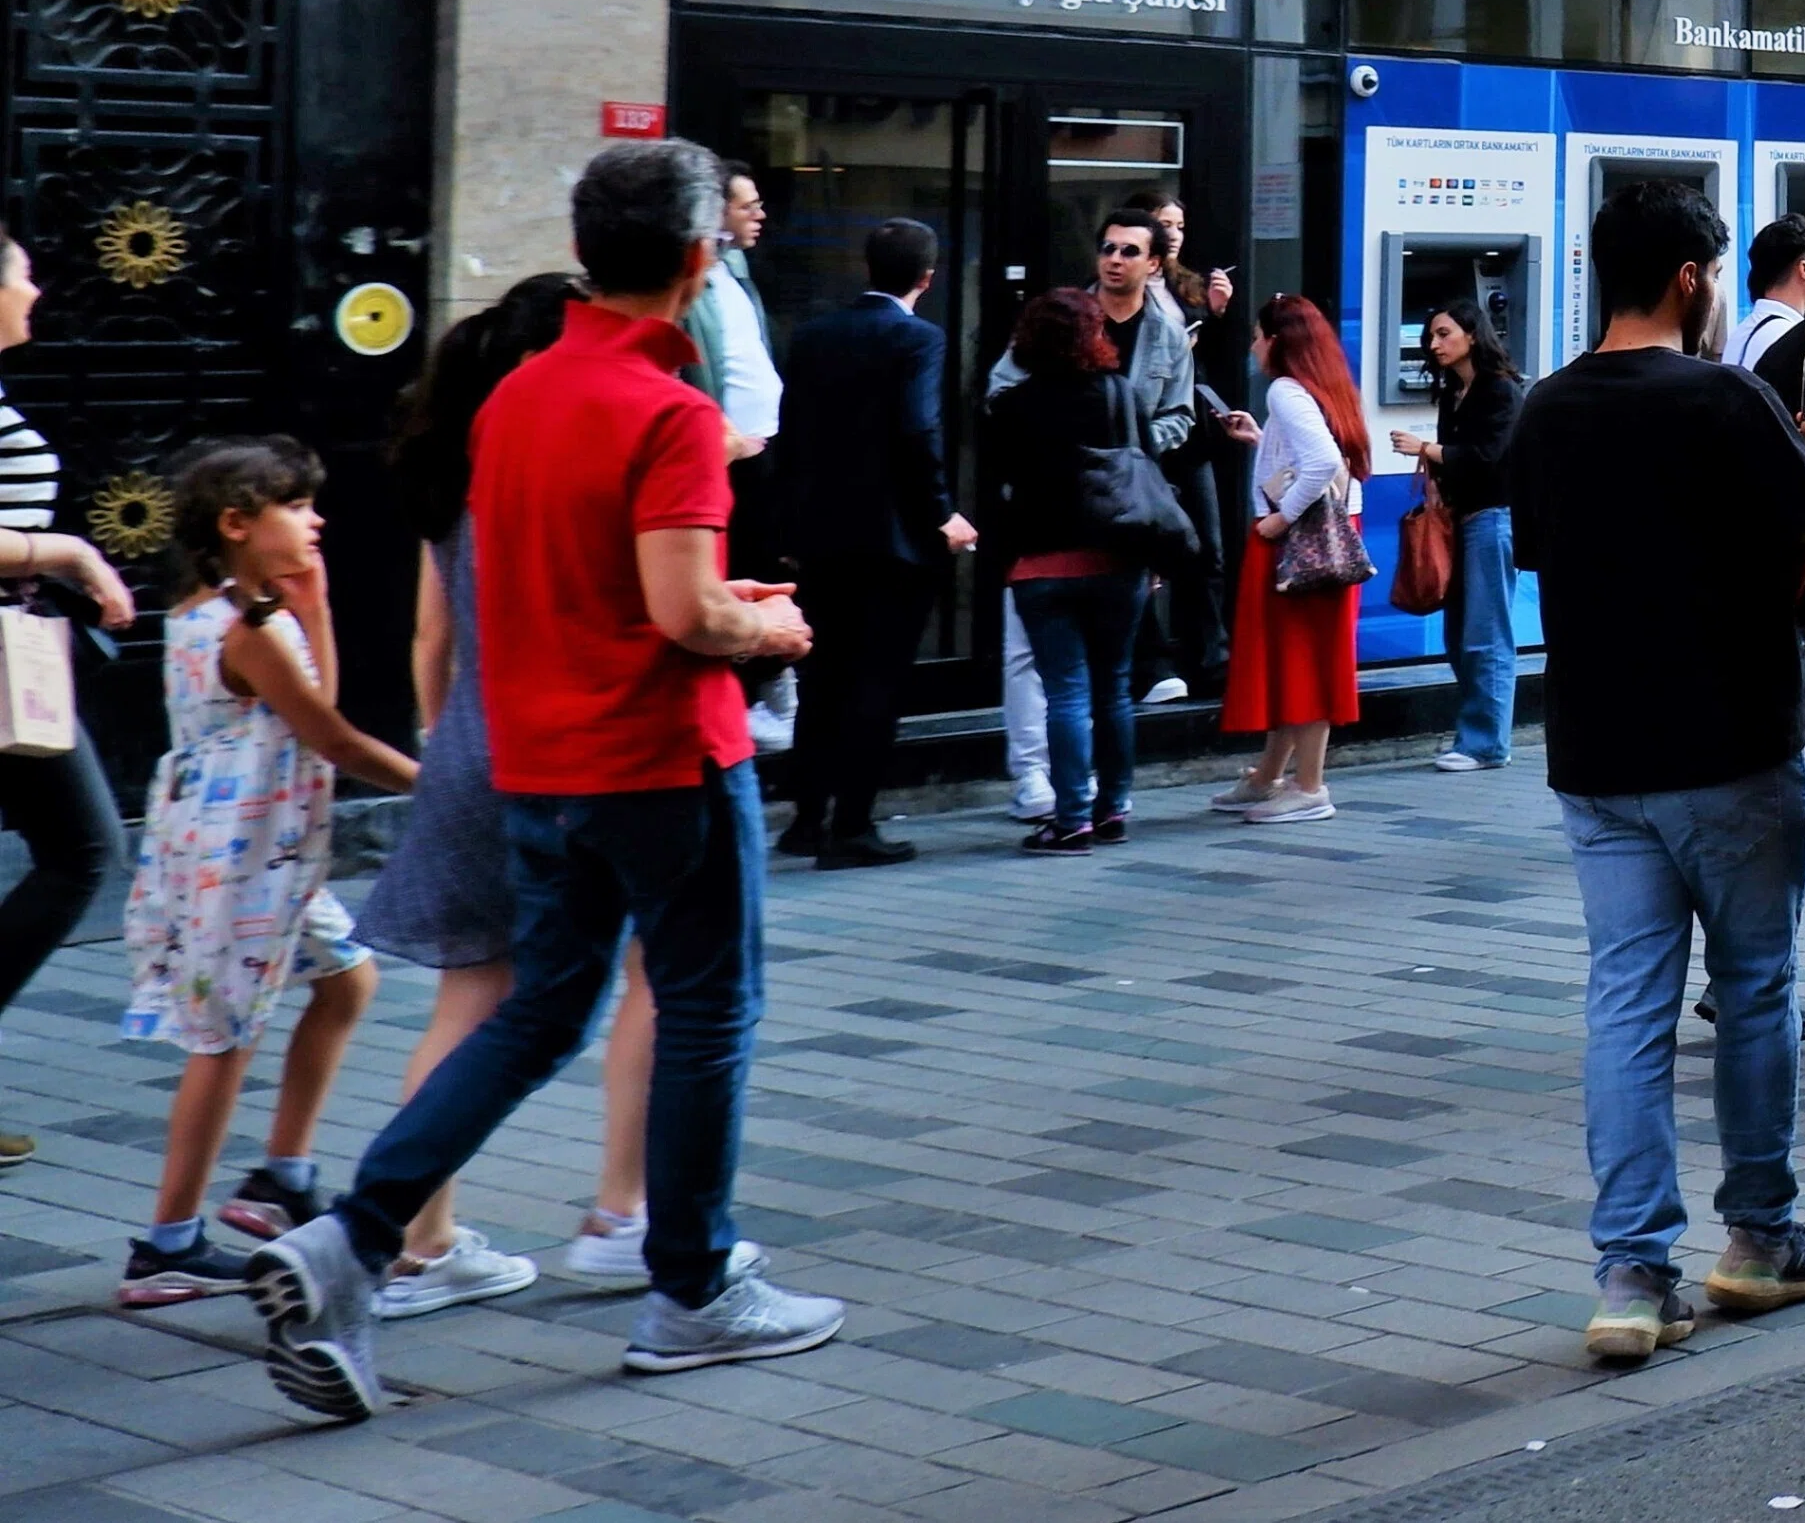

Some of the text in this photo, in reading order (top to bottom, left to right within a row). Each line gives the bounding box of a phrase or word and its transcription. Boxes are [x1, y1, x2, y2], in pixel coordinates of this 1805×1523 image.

[1386, 136, 1402, 148] TÜM
[1584, 143, 1599, 154] TÜM
[1769, 149, 1783, 161] TÜM
